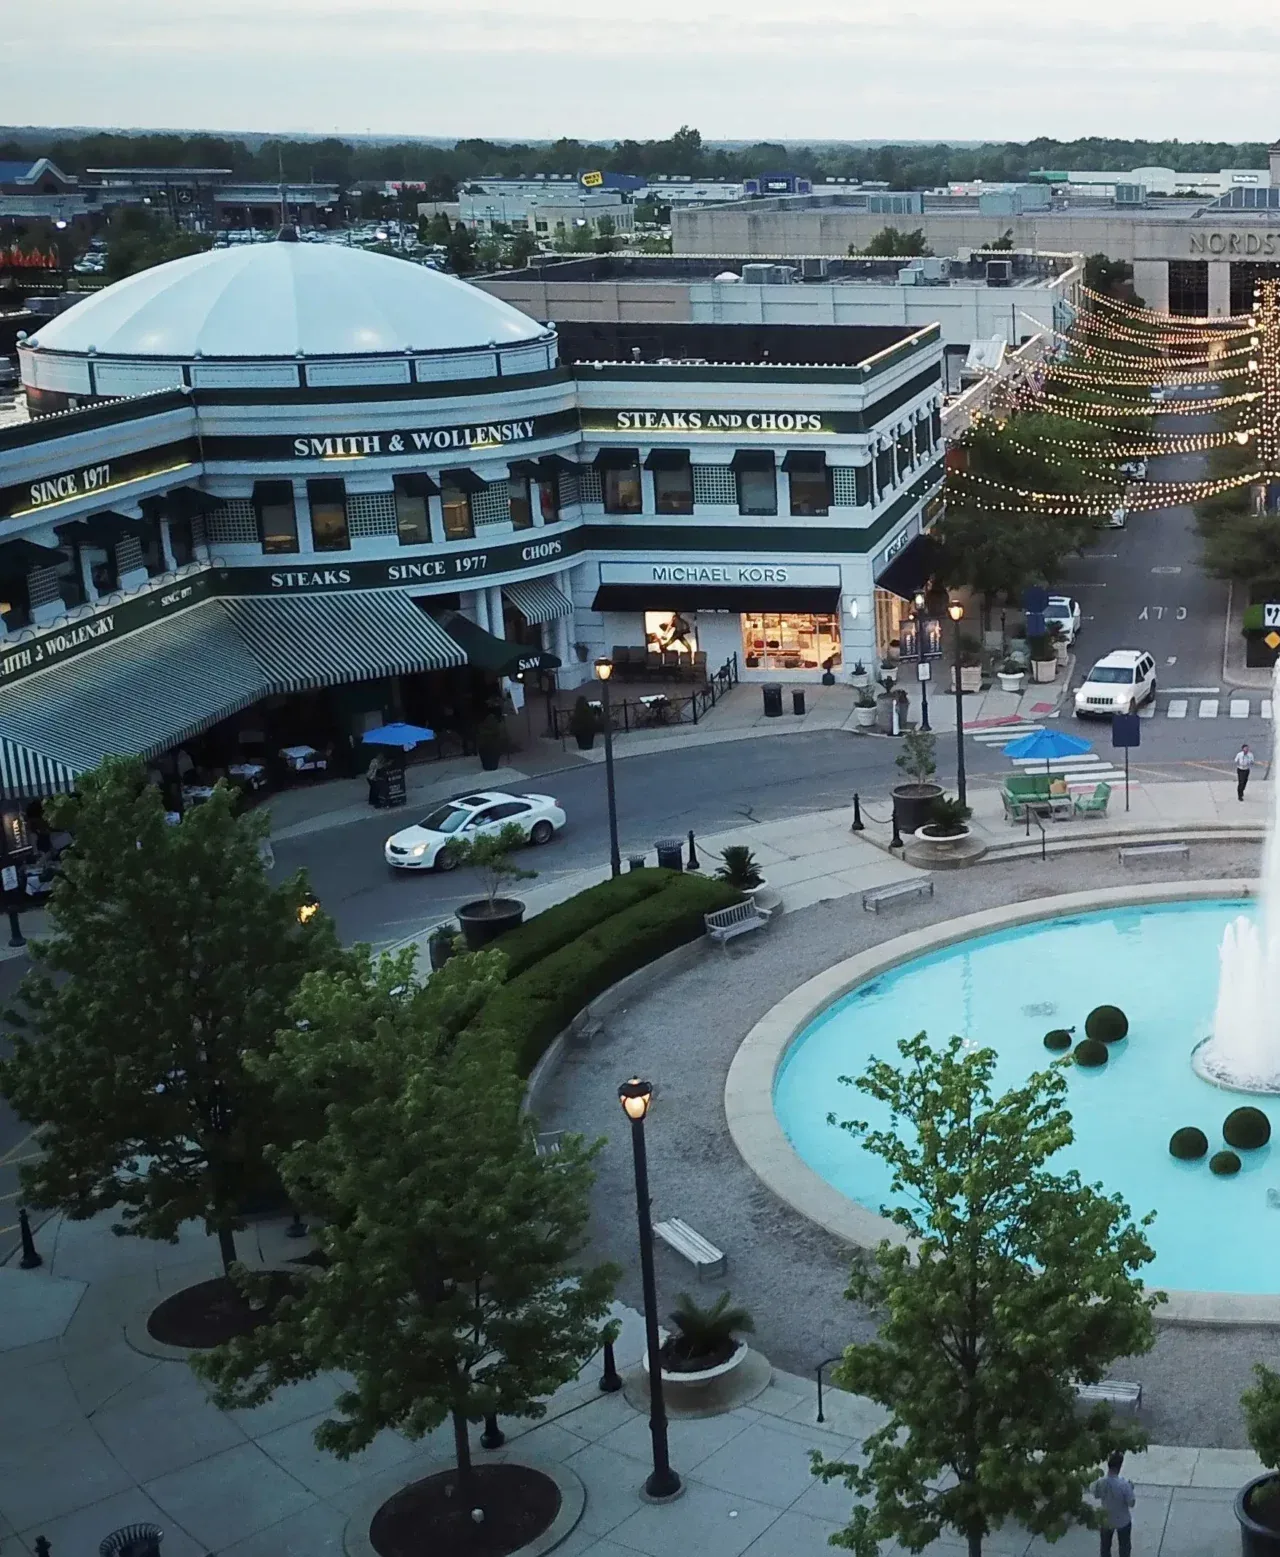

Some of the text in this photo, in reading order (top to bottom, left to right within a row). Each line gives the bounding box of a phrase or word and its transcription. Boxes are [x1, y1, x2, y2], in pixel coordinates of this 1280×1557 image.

[584, 173, 600, 181] BEST
[617, 411, 822, 430] STEAKS AND CHOPS
[294, 420, 536, 456] SMITH & WOLLENSKY
[30, 464, 110, 505] SINCE 1977
[521, 540, 562, 561] CHOPS
[388, 555, 488, 580] SINCE 1977
[652, 567, 788, 583] MICHAEL KORS
[271, 569, 351, 588] STEAKS
[518, 656, 540, 671] S&W
